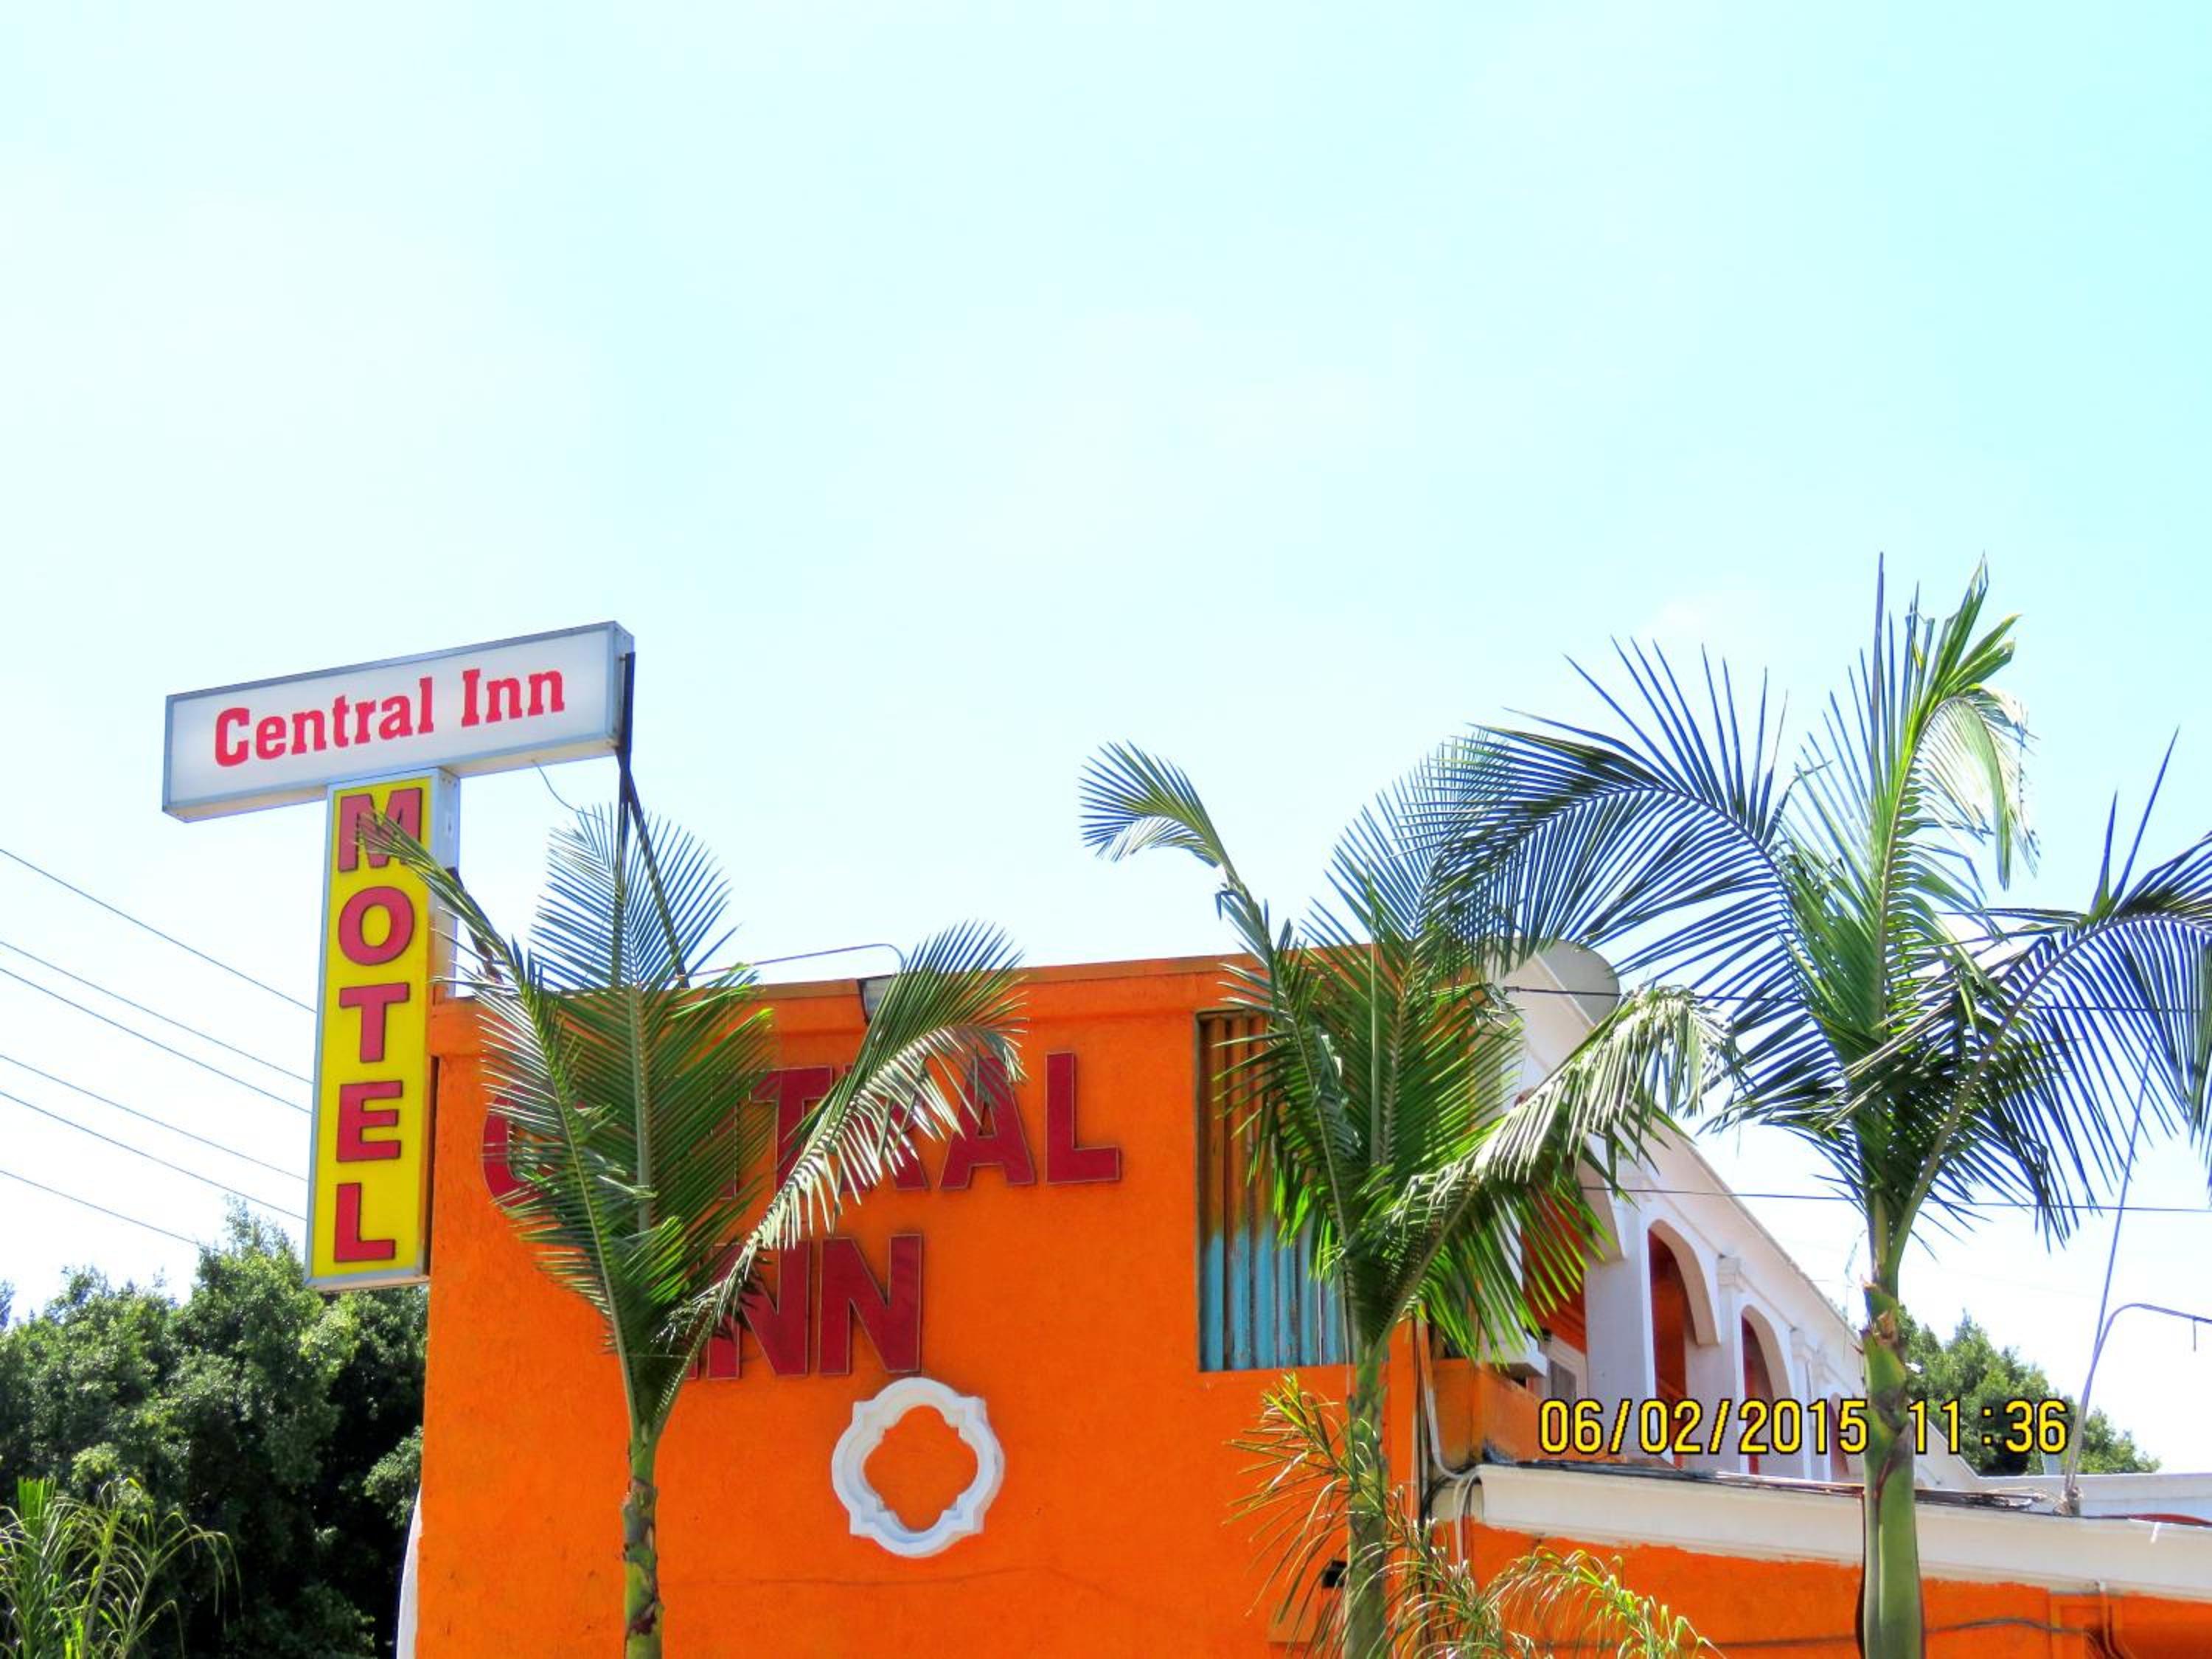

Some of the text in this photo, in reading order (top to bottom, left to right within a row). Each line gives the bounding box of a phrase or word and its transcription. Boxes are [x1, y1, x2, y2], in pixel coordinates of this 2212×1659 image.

[215, 668, 565, 767] Central Inn
[333, 787, 422, 1263] MOTEL
[677, 1234, 922, 1380] NN
